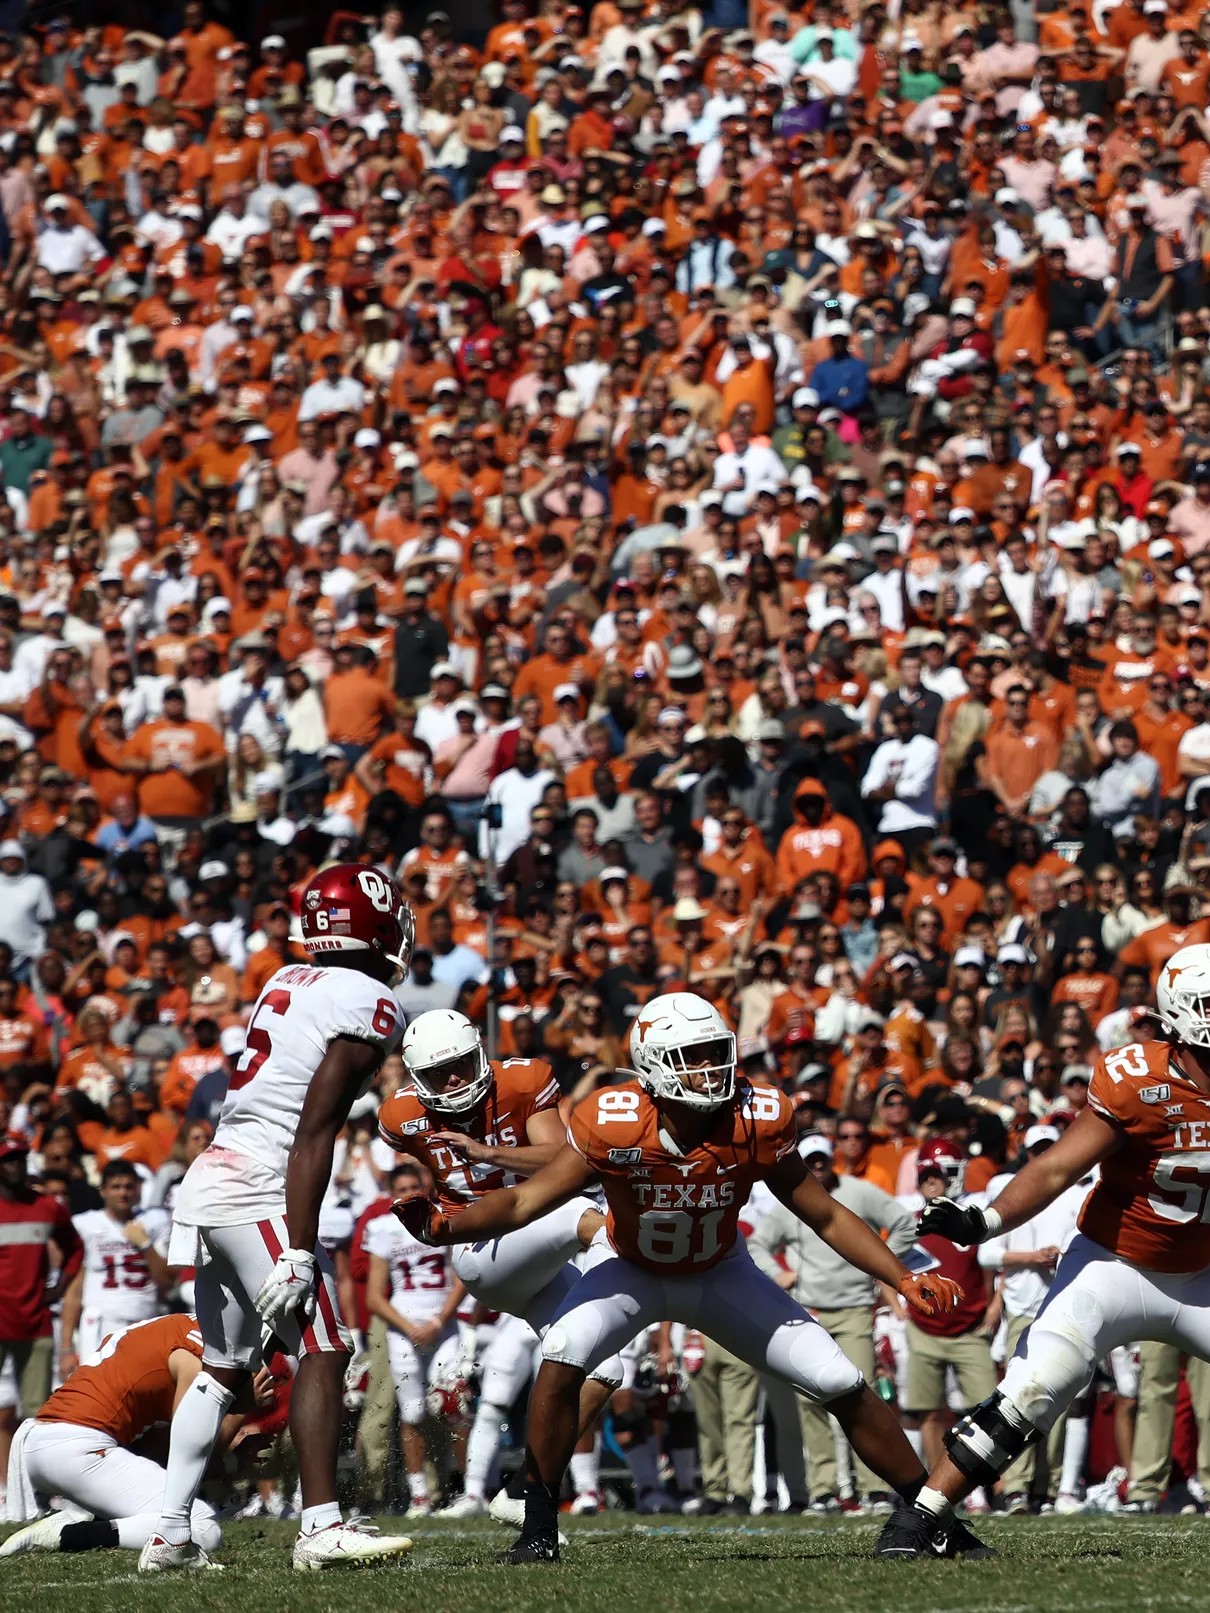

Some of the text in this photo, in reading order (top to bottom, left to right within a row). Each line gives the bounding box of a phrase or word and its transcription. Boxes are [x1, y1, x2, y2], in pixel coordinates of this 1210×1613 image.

[358, 871, 393, 913] OU
[316, 911, 329, 930] 6
[275, 966, 329, 987] BROWN
[372, 997, 397, 1036] 6
[229, 989, 291, 1091] 6
[597, 1091, 640, 1125] 81
[1140, 1085, 1169, 1104] 150
[430, 1127, 517, 1170] TEAS
[632, 1181, 735, 1208] TEXAS
[637, 1210, 725, 1264] 81
[103, 1255, 149, 1289] 15
[398, 1254, 446, 1290] 13
